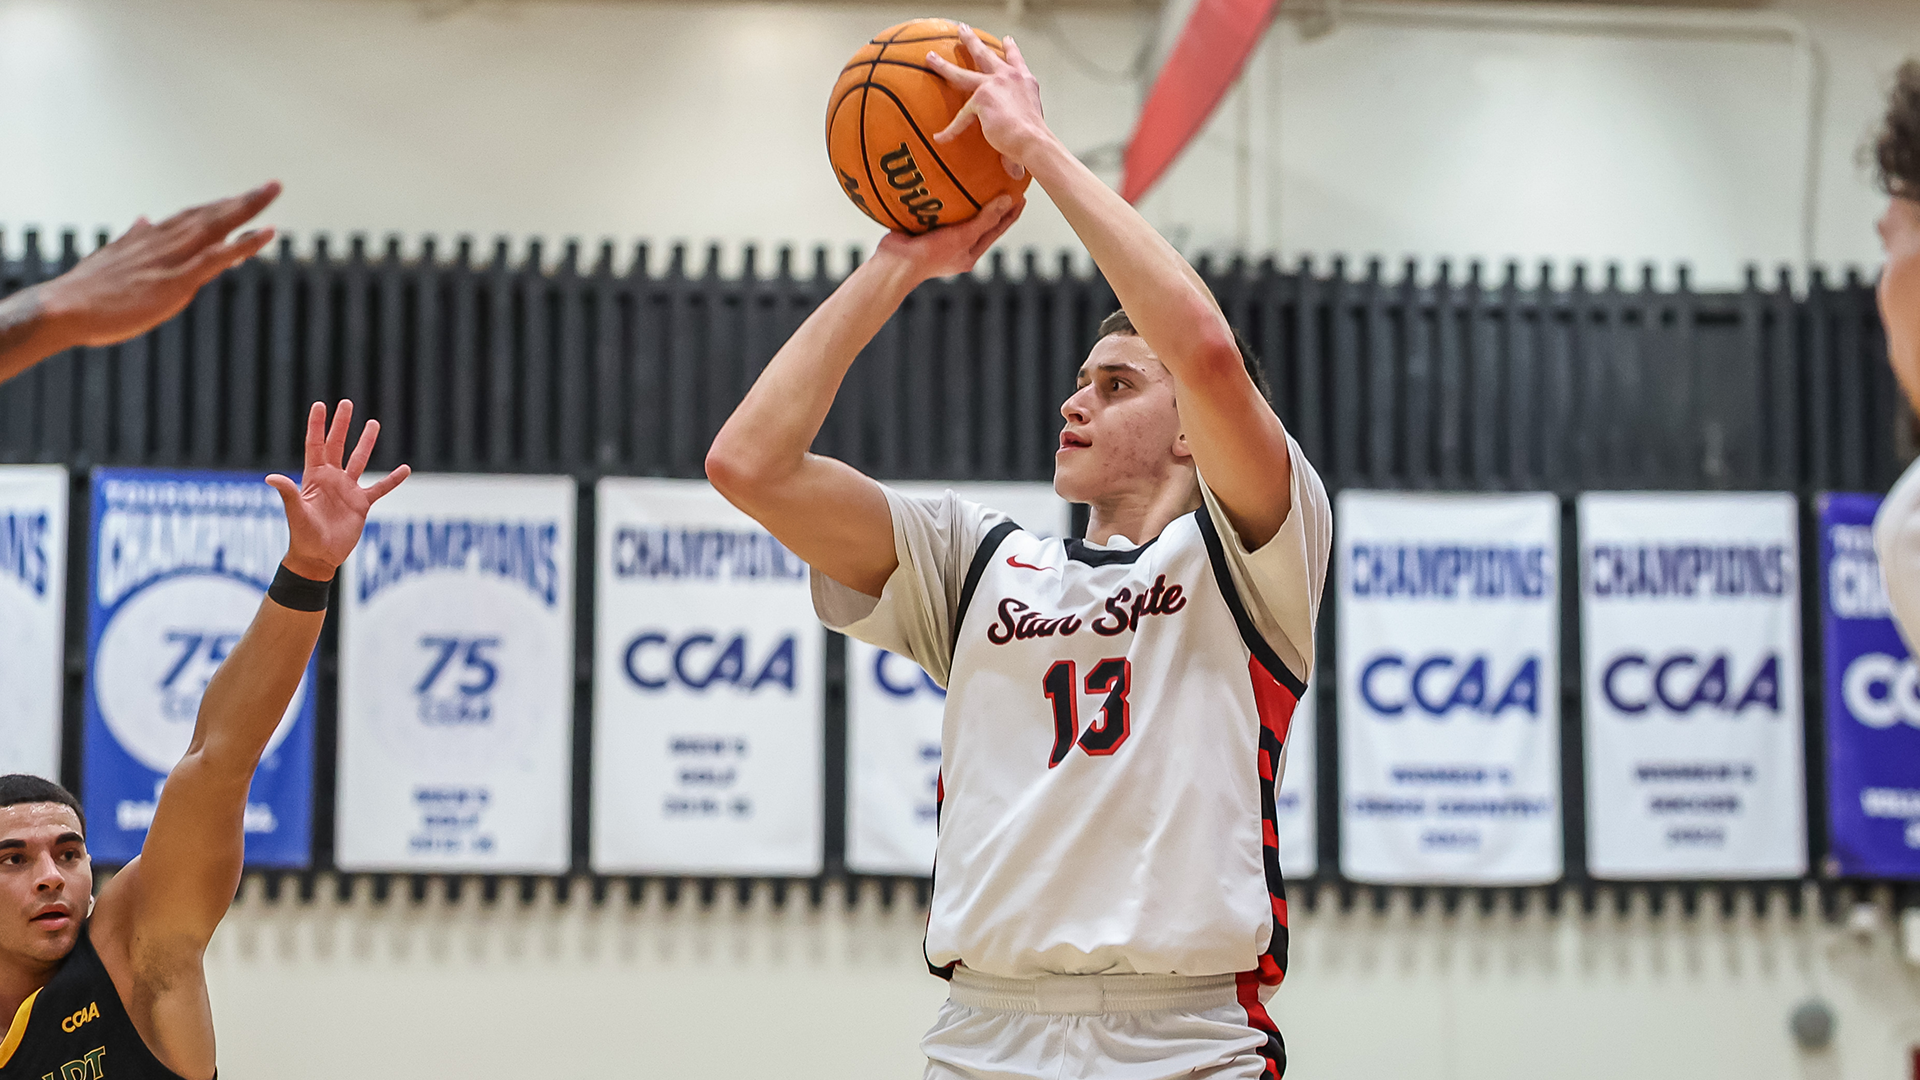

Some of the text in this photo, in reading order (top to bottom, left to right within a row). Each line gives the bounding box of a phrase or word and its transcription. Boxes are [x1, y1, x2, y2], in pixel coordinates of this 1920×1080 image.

[879, 141, 944, 232] Wils
[356, 519, 557, 604] CHAMPIONS
[1353, 546, 1543, 597] CHAMPIONS
[1594, 546, 1783, 597] CHAMPIONS
[987, 597, 1083, 646] Stan
[416, 636, 502, 695] 75
[624, 634, 797, 690] CCAA
[1361, 656, 1539, 717] CCAA
[1602, 655, 1779, 714] CCAA
[1042, 656, 1132, 770] 13
[61, 1001, 101, 1034] CCAA
